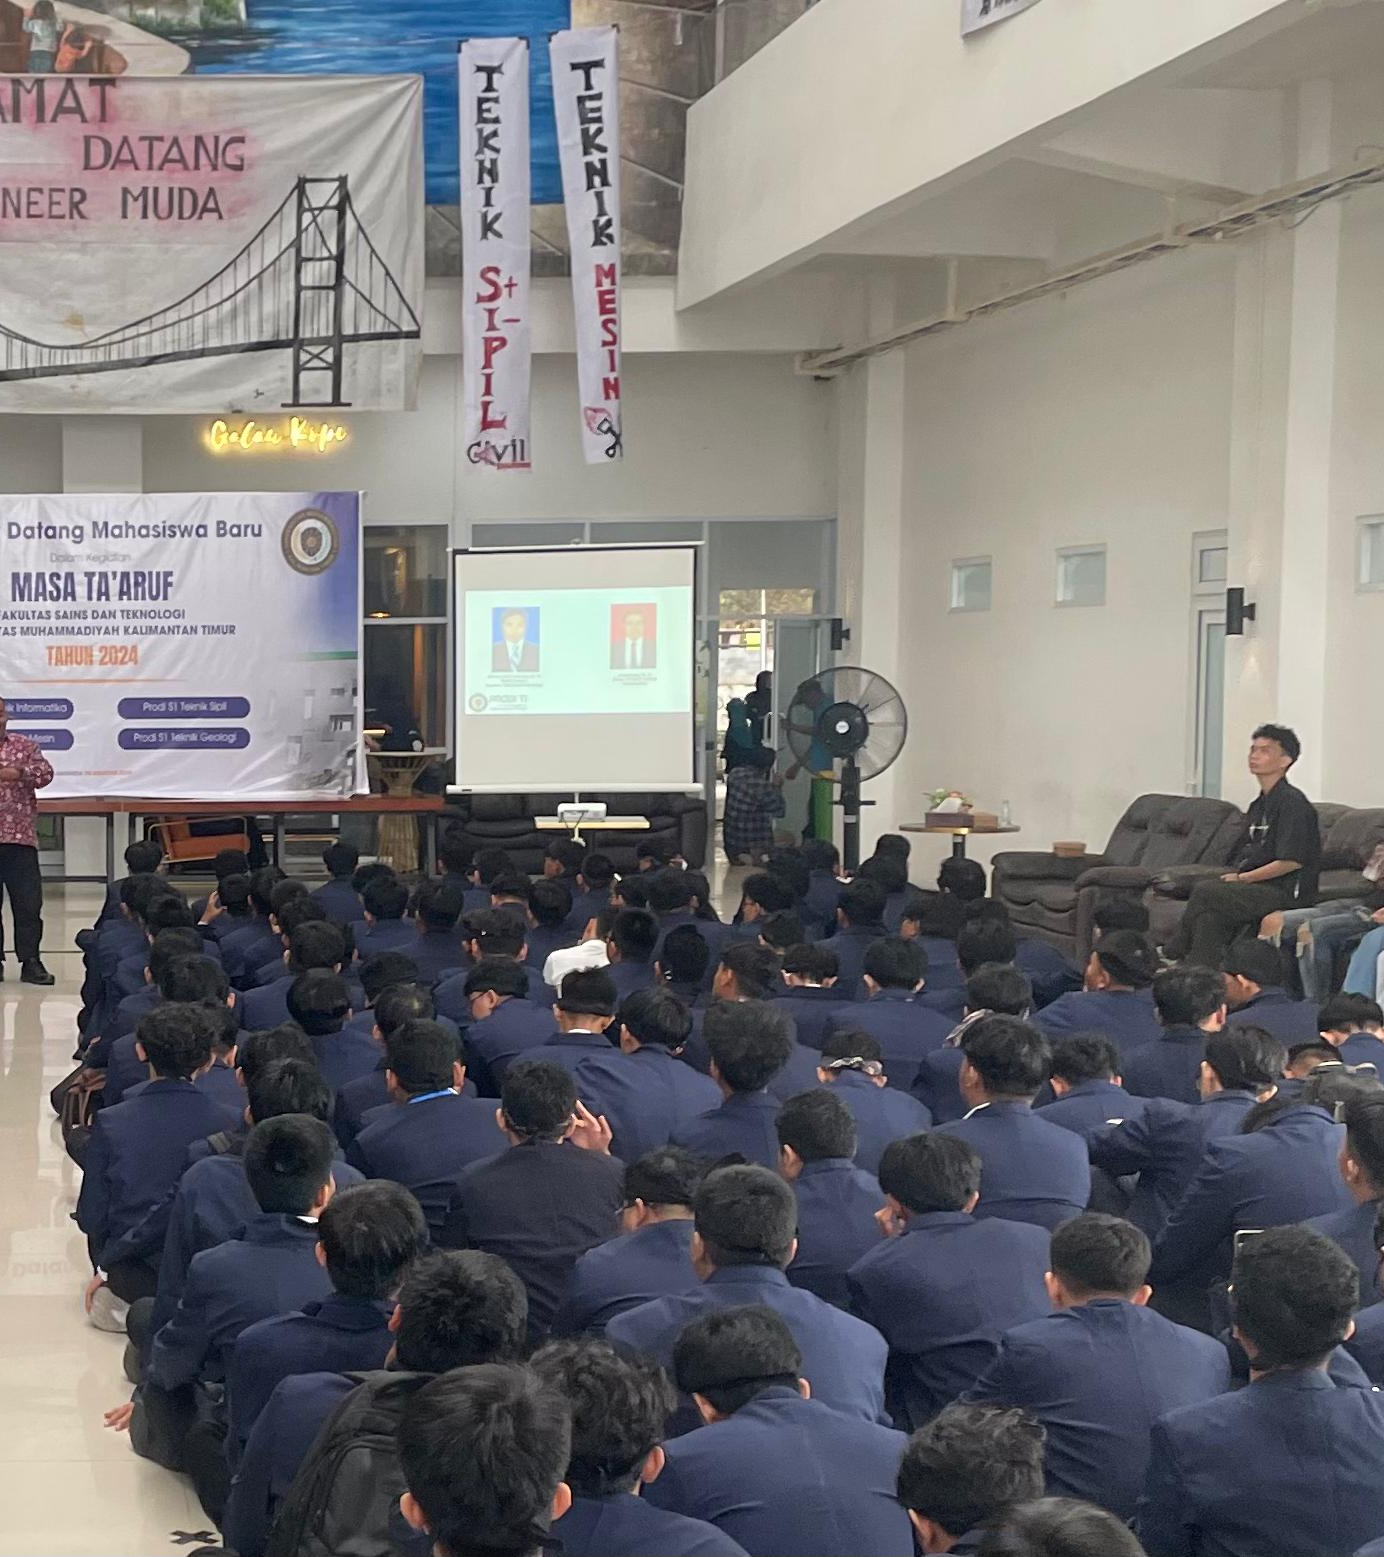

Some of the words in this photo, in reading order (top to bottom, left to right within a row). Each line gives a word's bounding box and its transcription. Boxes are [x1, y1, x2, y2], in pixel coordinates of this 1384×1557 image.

[82, 135, 246, 172] DATANG
[474, 62, 504, 241] TEKNIK
[120, 186, 225, 220] MUDA
[569, 58, 616, 247] TEKNIK
[595, 263, 621, 400] MESIN
[475, 266, 508, 432] SIPIL
[7, 521, 85, 544] Datang
[92, 520, 208, 539] Mahasiswa
[216, 519, 263, 538] Baru
[11, 571, 76, 602] MASA
[84, 570, 174, 602] TA'ARUF
[54, 610, 88, 620] SAINS
[91, 609, 117, 620] DAN
[120, 609, 186, 620] TEKNOLOGI
[20, 625, 120, 637] MUHAMMADIYAH
[123, 625, 198, 636] KALIMANTAN
[201, 624, 236, 636] TIMUR
[46, 645, 93, 666] TAHUN
[99, 645, 139, 666] 2024
[16, 702, 68, 713] Informatika
[142, 702, 166, 713] Prodi
[168, 702, 178, 712] S1
[181, 702, 207, 712] Teknik
[133, 732, 157, 743] Prodi
[158, 732, 168, 743] S1
[171, 731, 198, 743] Teknik
[200, 731, 238, 744] Geologi
